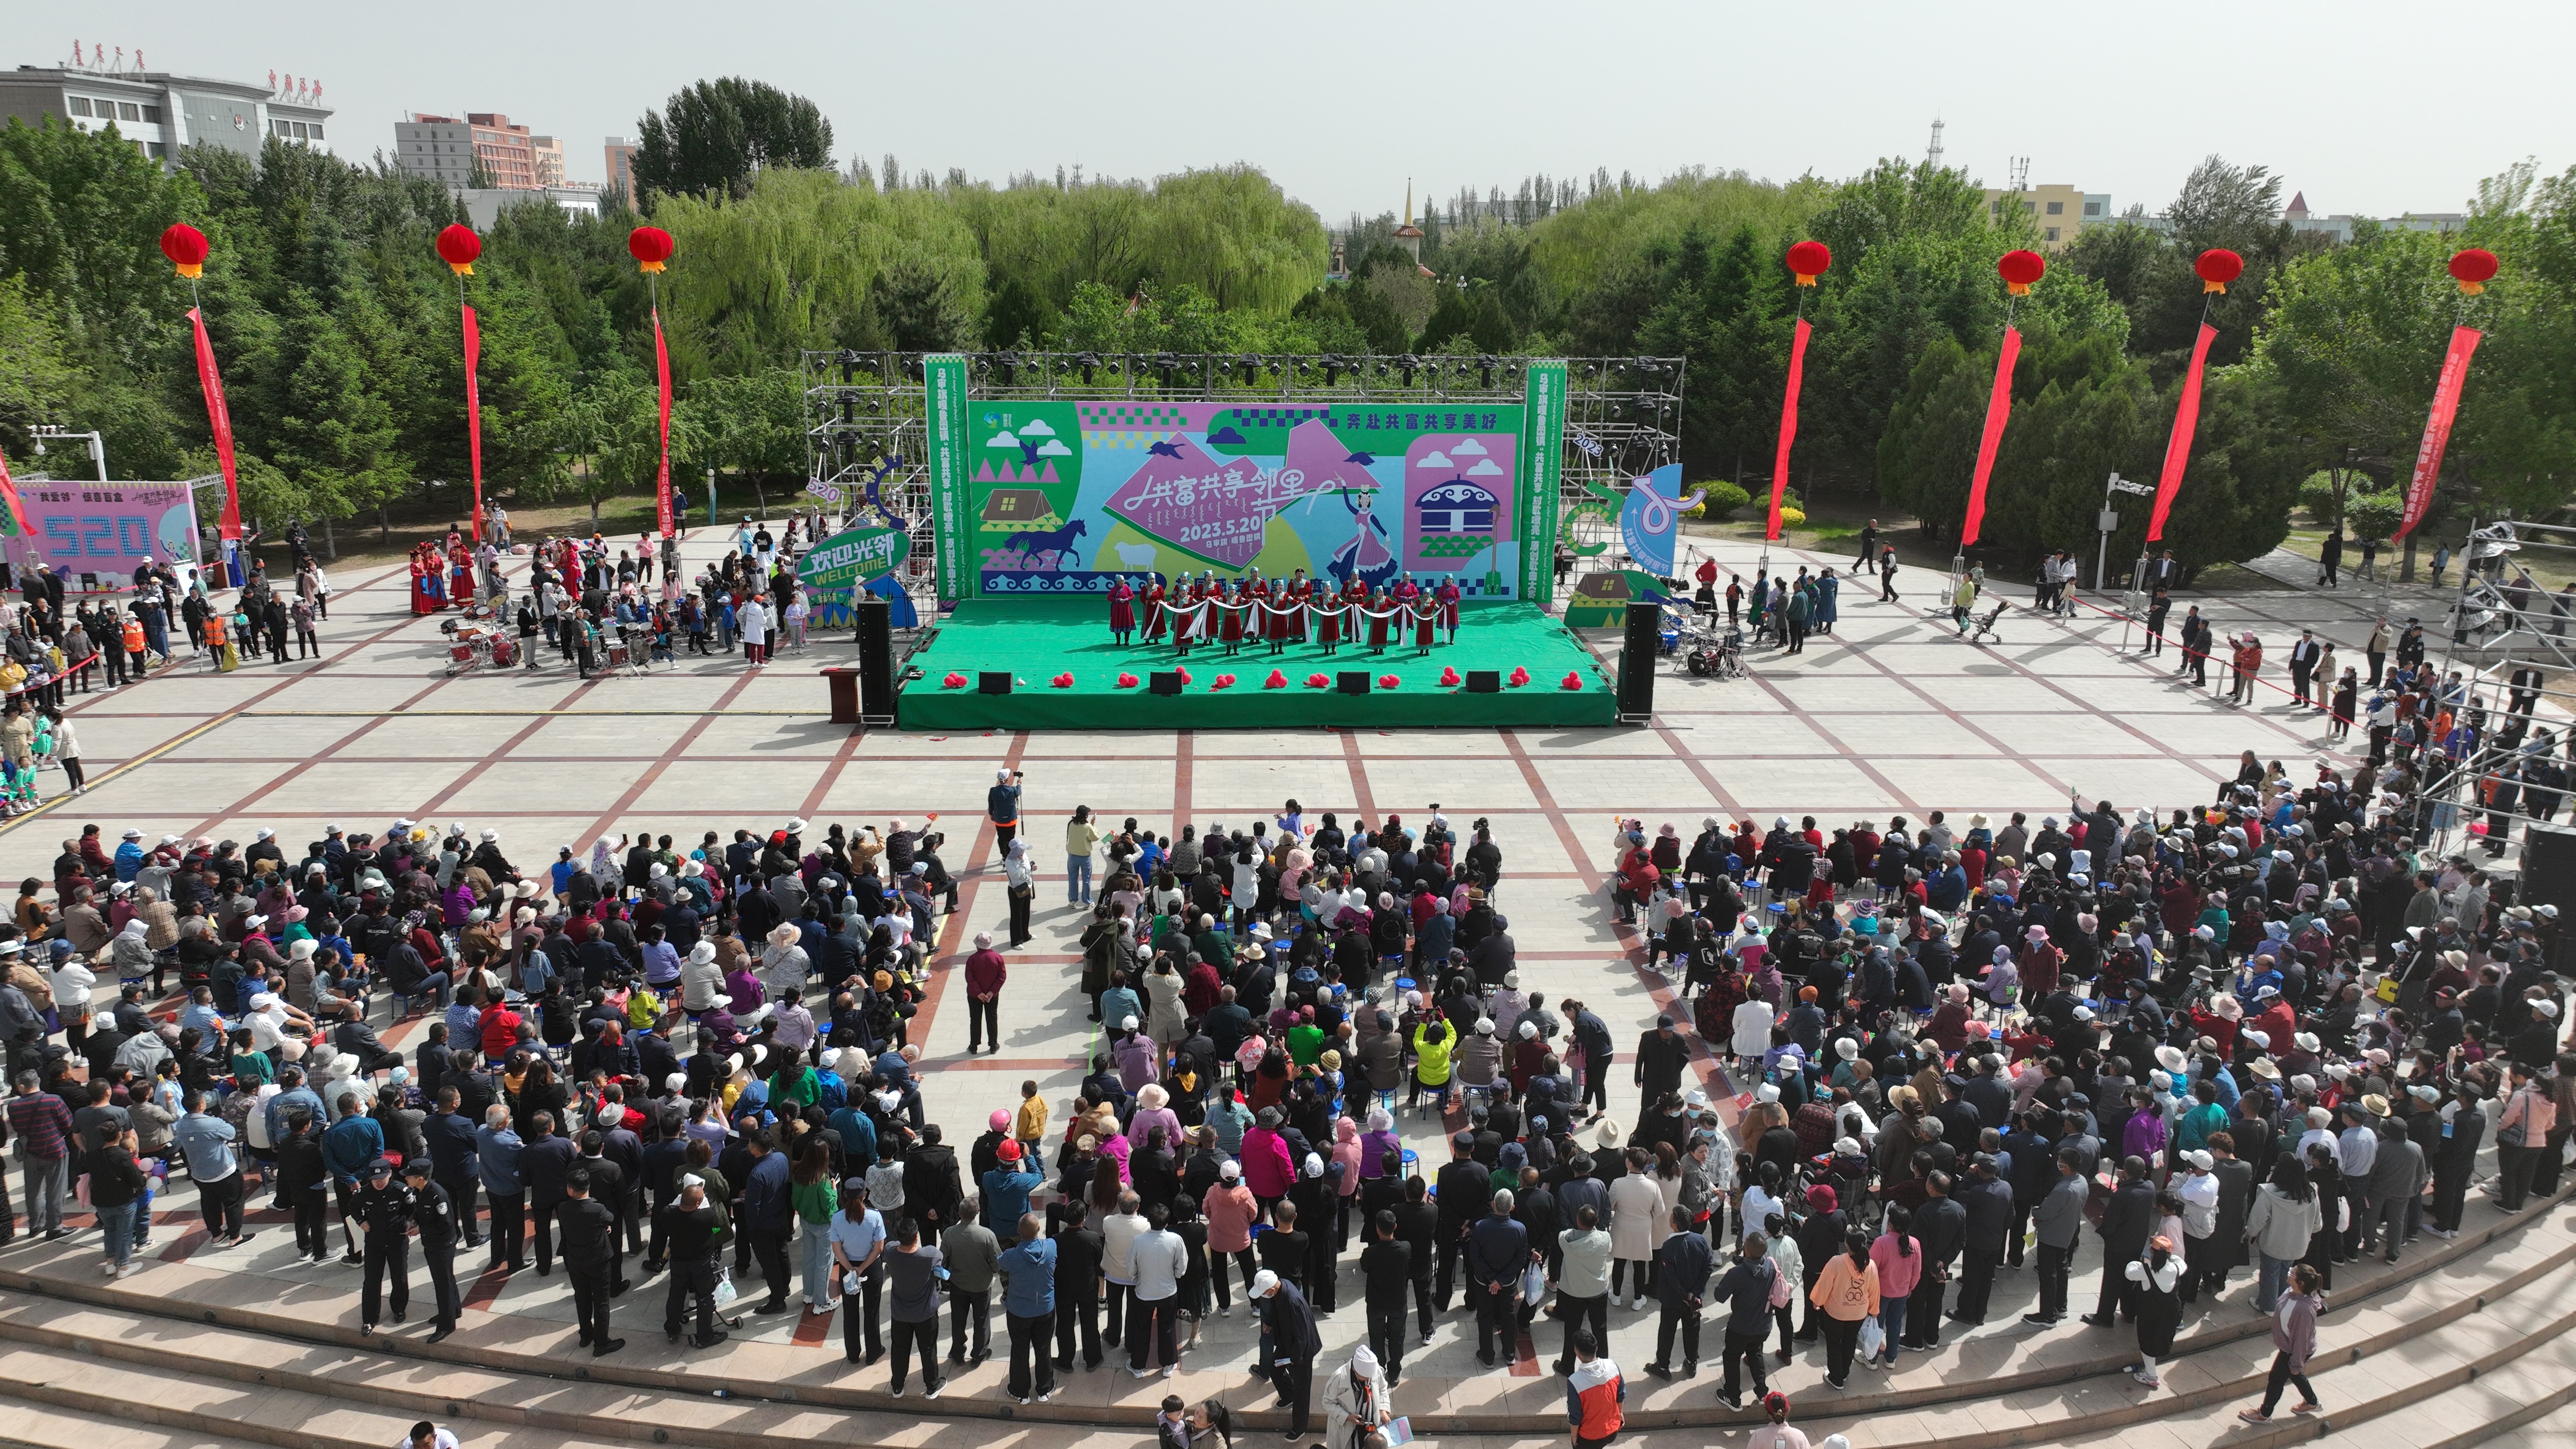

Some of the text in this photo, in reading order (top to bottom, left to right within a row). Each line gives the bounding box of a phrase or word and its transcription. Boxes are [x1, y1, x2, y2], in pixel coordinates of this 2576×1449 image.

[1347, 413, 1497, 430] 奔赴共富共享美好
[1573, 433, 1604, 457] 2023
[82, 492, 123, 503] 惊喜盲盒
[806, 478, 839, 502] 520
[44, 516, 153, 557] 520
[1180, 515, 1261, 543] 2023.5.20
[1624, 527, 1670, 572] 共富共享邻里节
[814, 556, 887, 586] WELCOME
